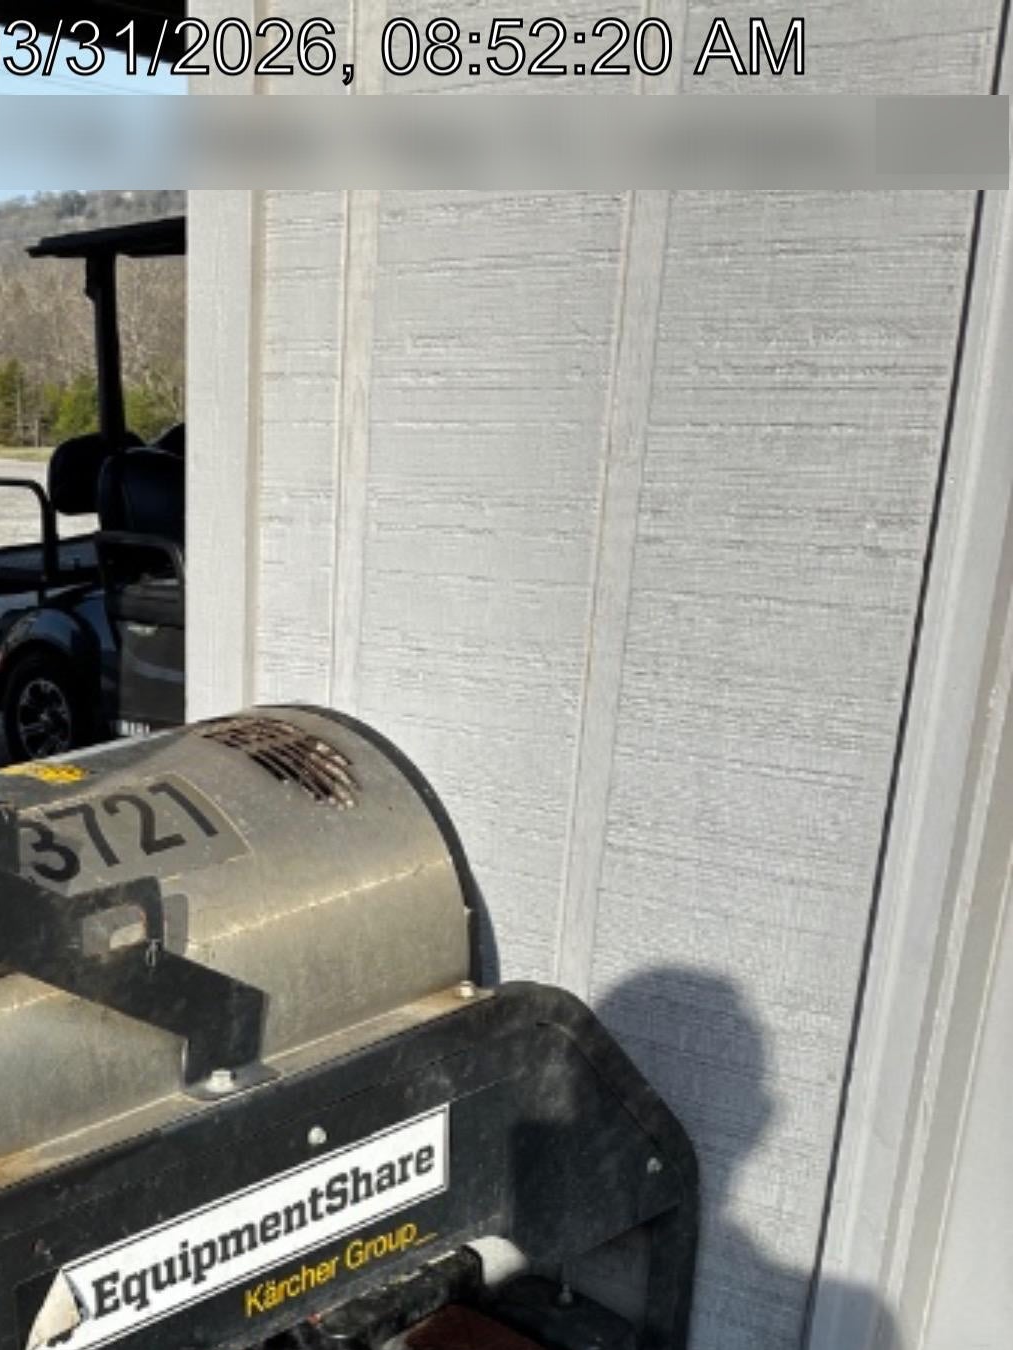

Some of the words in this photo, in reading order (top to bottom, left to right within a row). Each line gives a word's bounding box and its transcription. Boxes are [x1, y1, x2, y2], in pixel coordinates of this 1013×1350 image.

[19, 782, 218, 881] 3721
[92, 1144, 435, 1320] EquipmentShare
[244, 1257, 338, 1316] Kärcher
